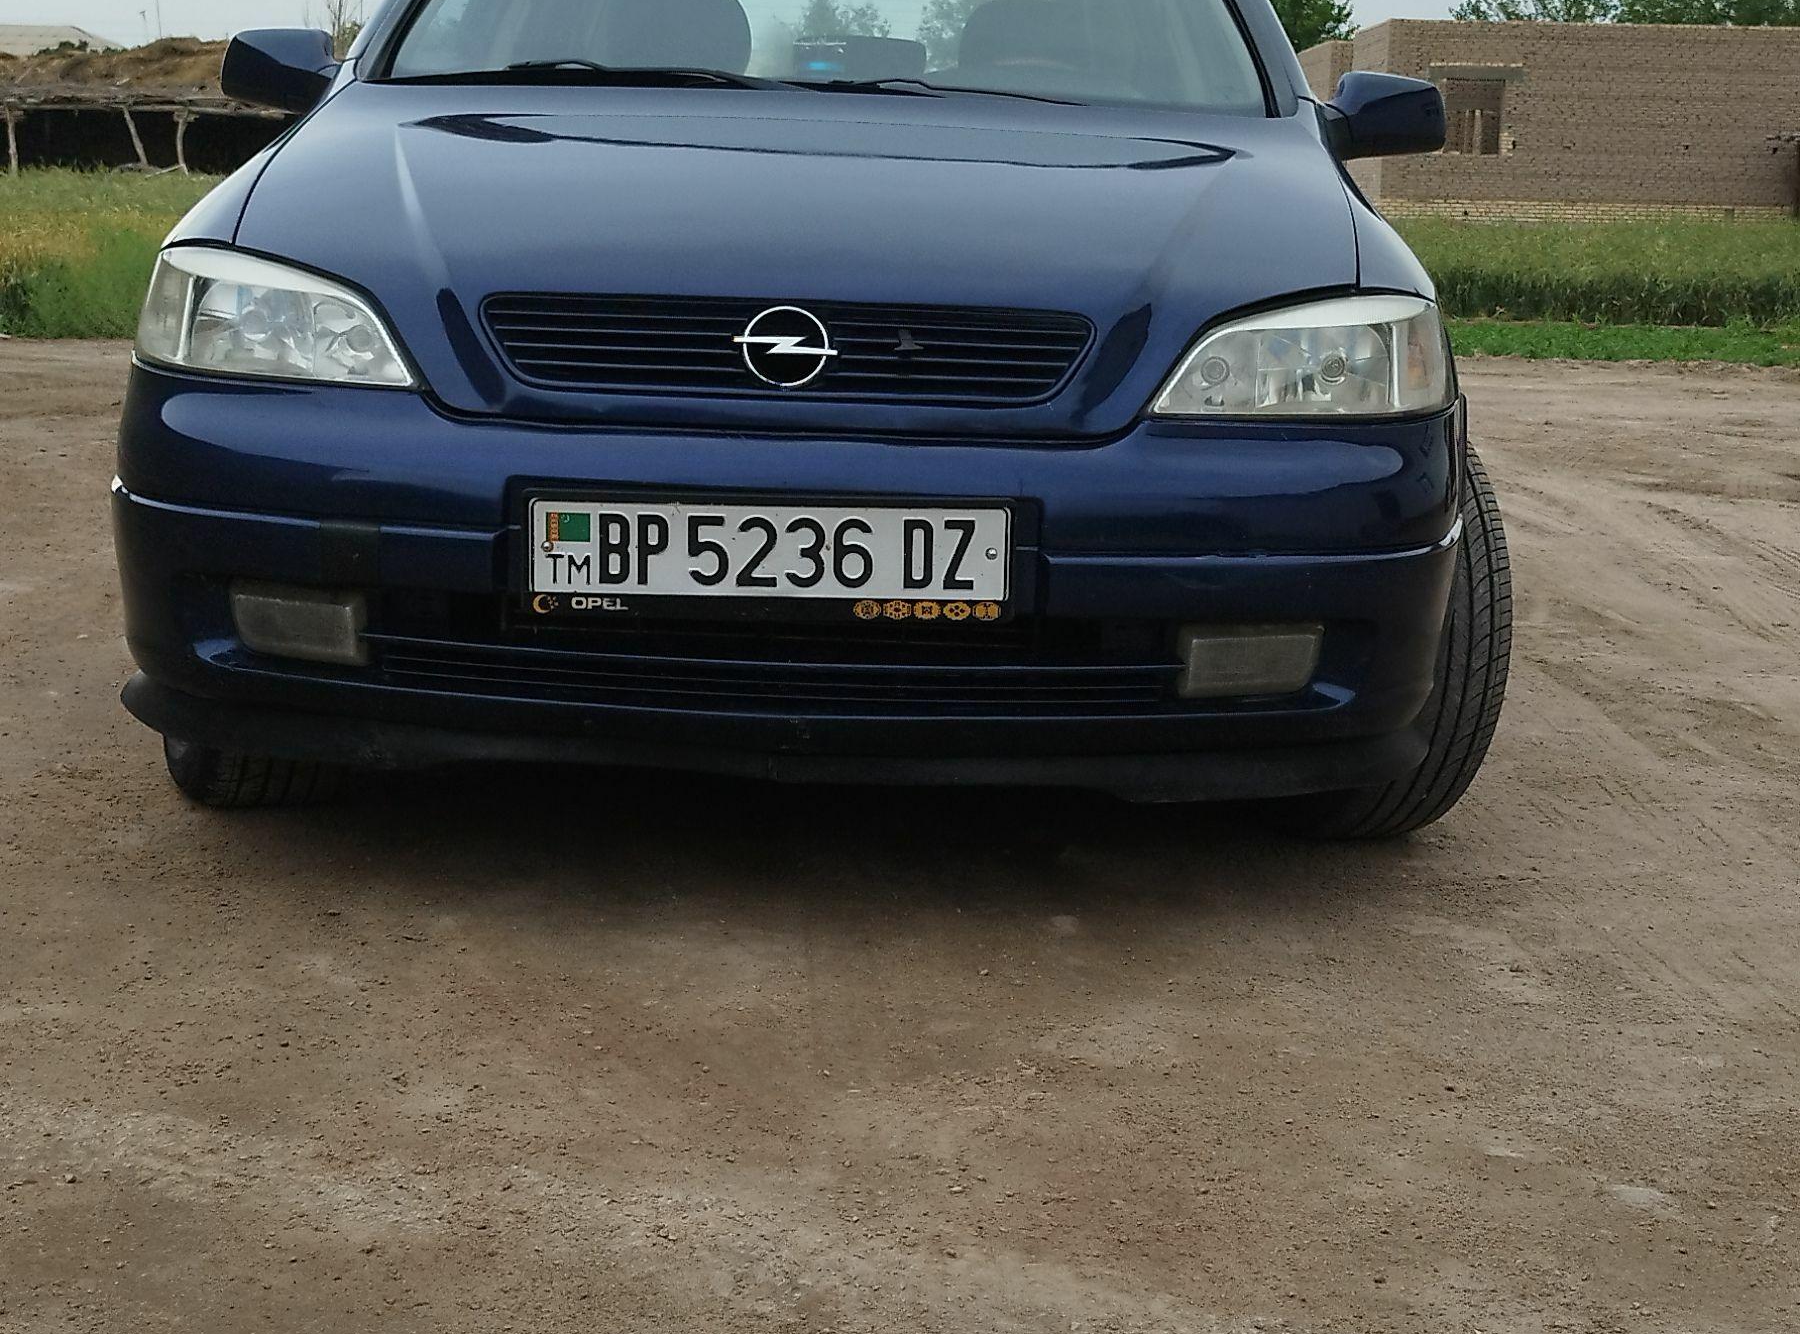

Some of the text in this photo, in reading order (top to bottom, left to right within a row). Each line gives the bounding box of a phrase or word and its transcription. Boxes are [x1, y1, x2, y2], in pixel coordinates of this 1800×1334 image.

[599, 513, 976, 590] BP 5236 DZ
[546, 554, 591, 585] TM
[571, 596, 629, 610] OPEL
